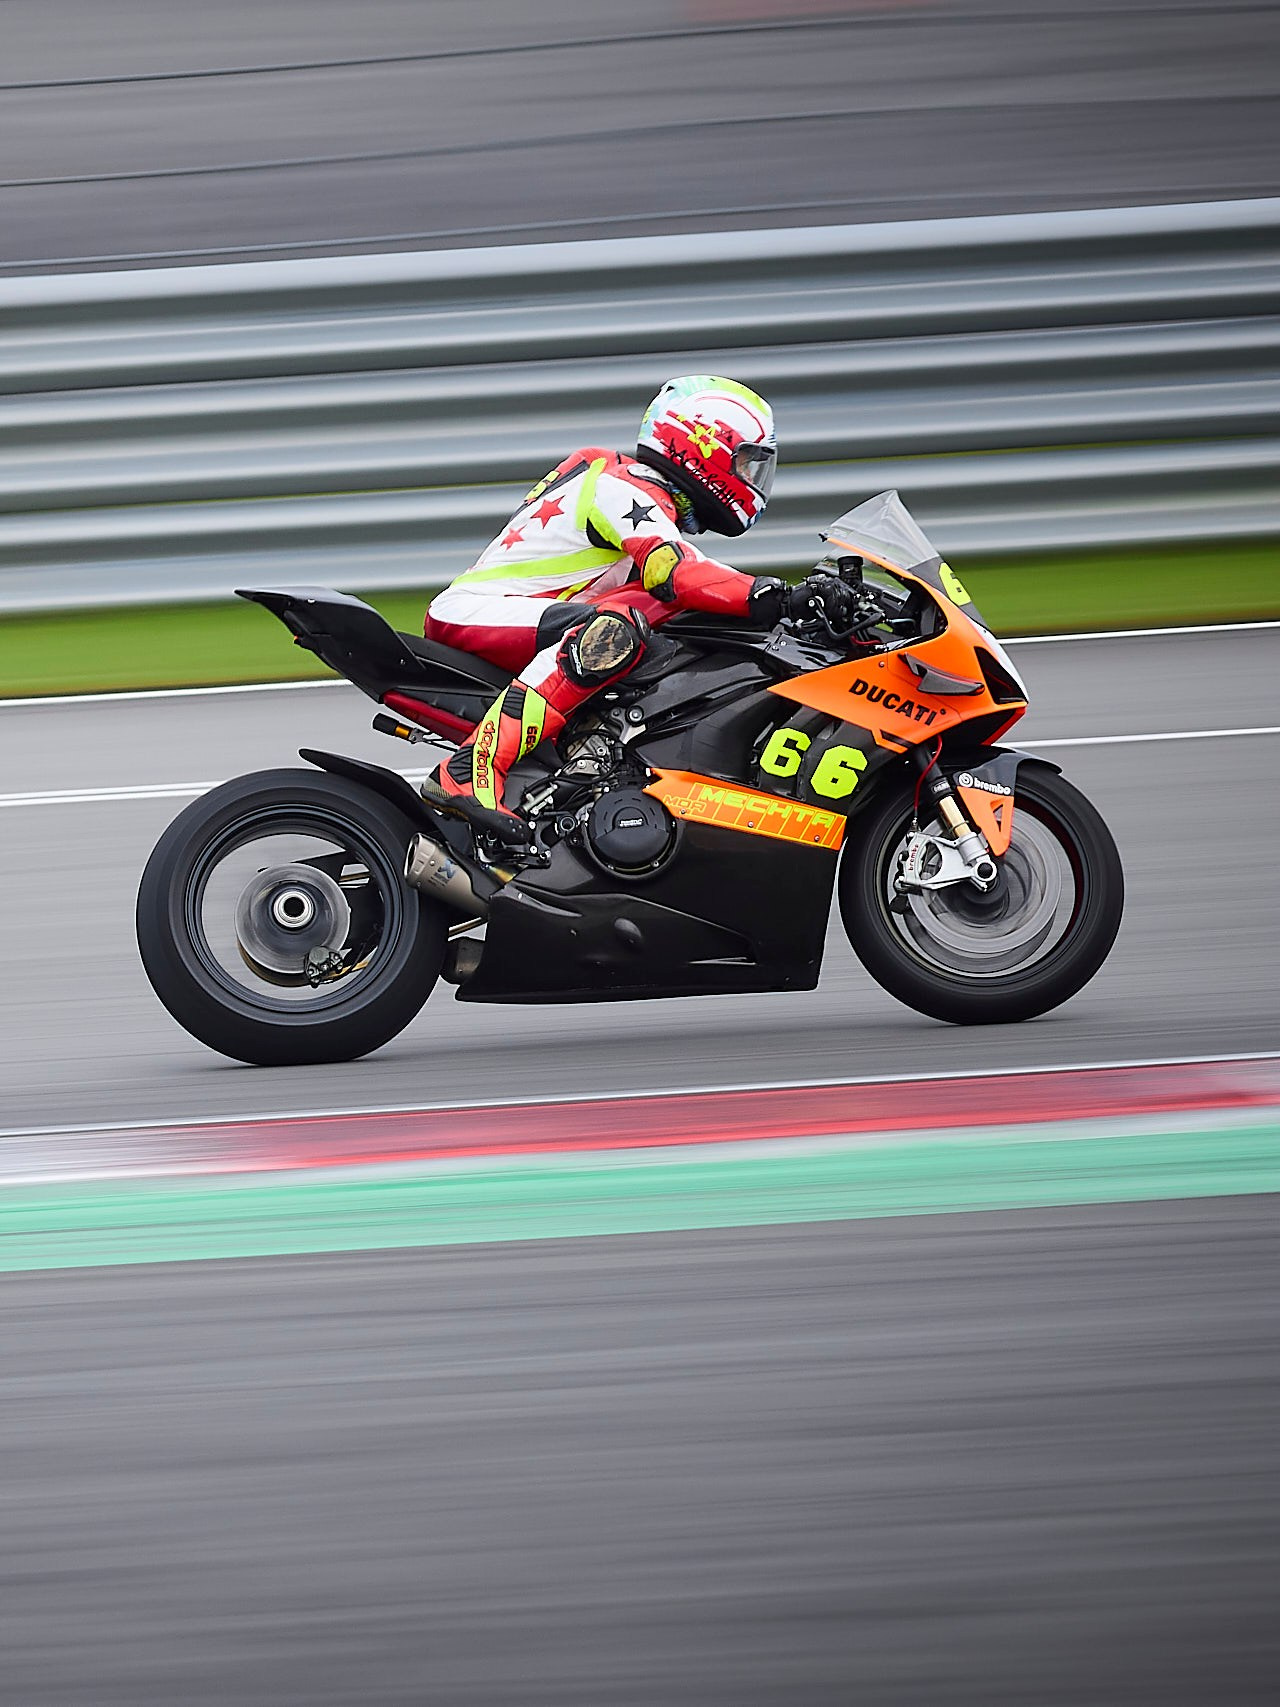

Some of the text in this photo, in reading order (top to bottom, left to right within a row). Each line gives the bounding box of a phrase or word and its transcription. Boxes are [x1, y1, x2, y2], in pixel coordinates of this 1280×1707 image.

[848, 678, 937, 726] DUCATI
[477, 720, 495, 788] daytona
[759, 727, 868, 800] 66
[701, 786, 835, 828] MECHTA
[973, 776, 1011, 795] brembo
